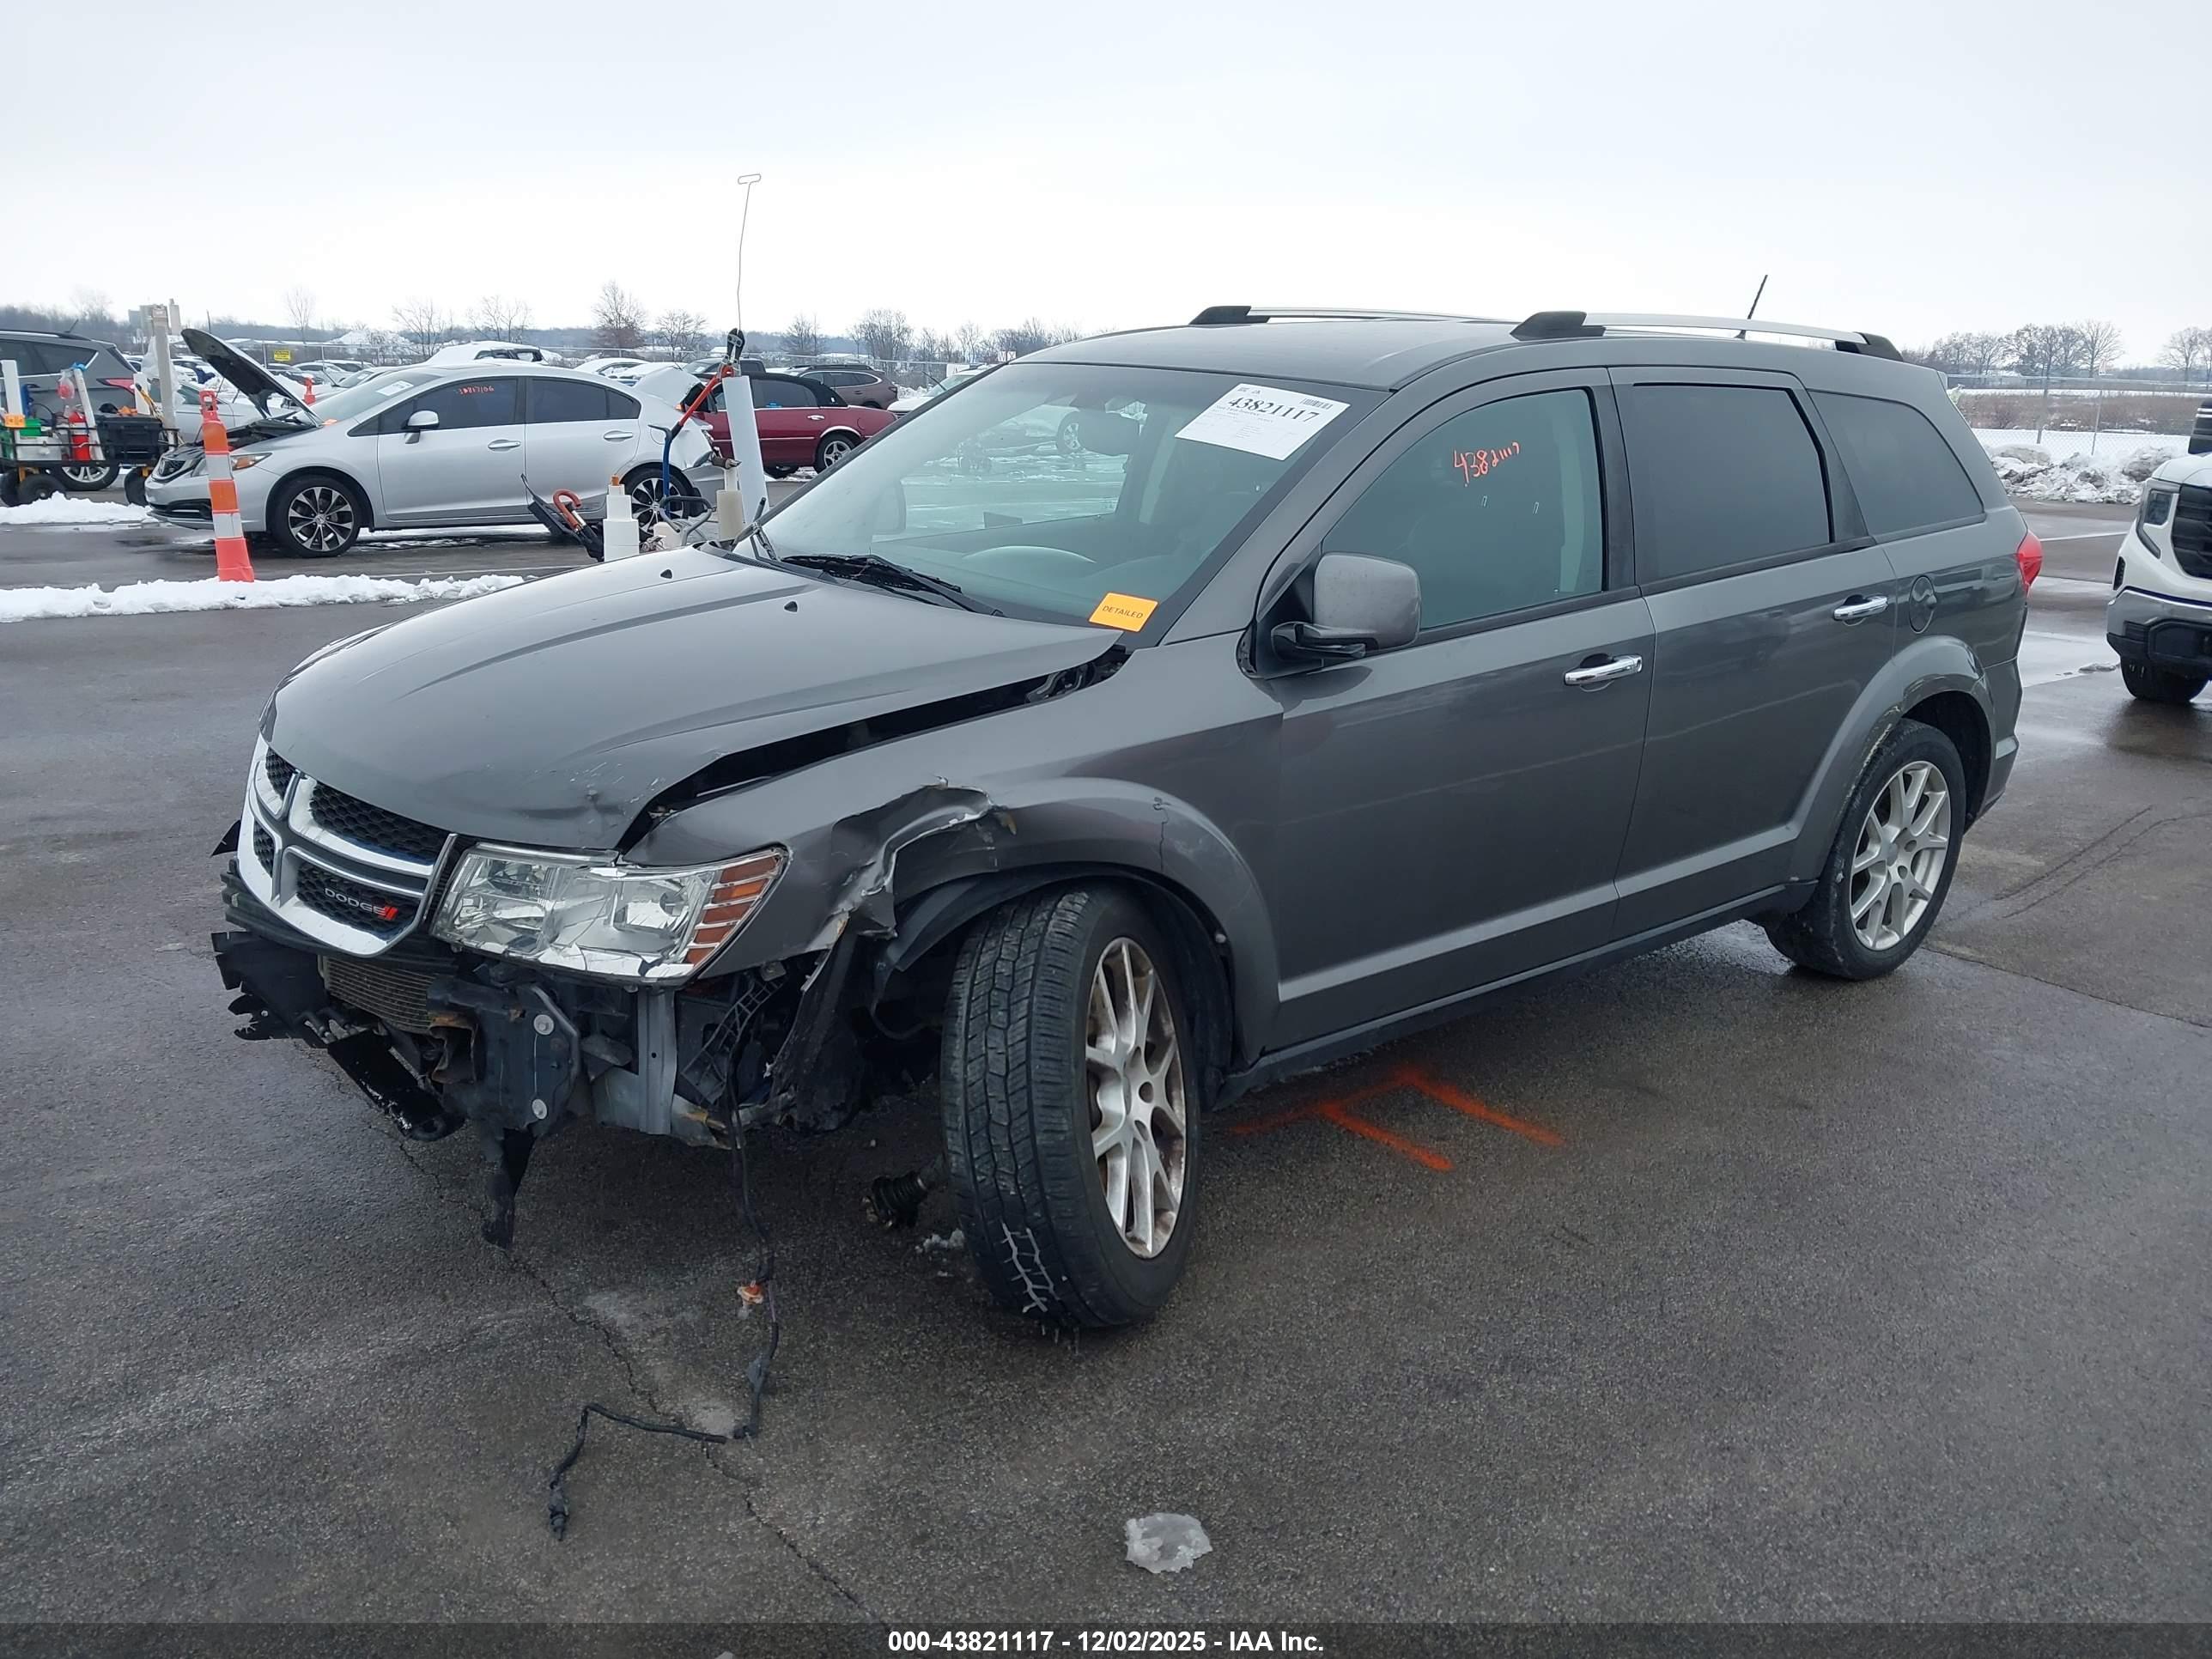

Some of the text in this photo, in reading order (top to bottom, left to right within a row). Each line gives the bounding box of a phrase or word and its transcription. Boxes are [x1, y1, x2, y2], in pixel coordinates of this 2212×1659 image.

[1228, 397, 1320, 422] 43821117
[1102, 605, 1144, 619] DETAILED
[323, 887, 387, 917] DODGE
